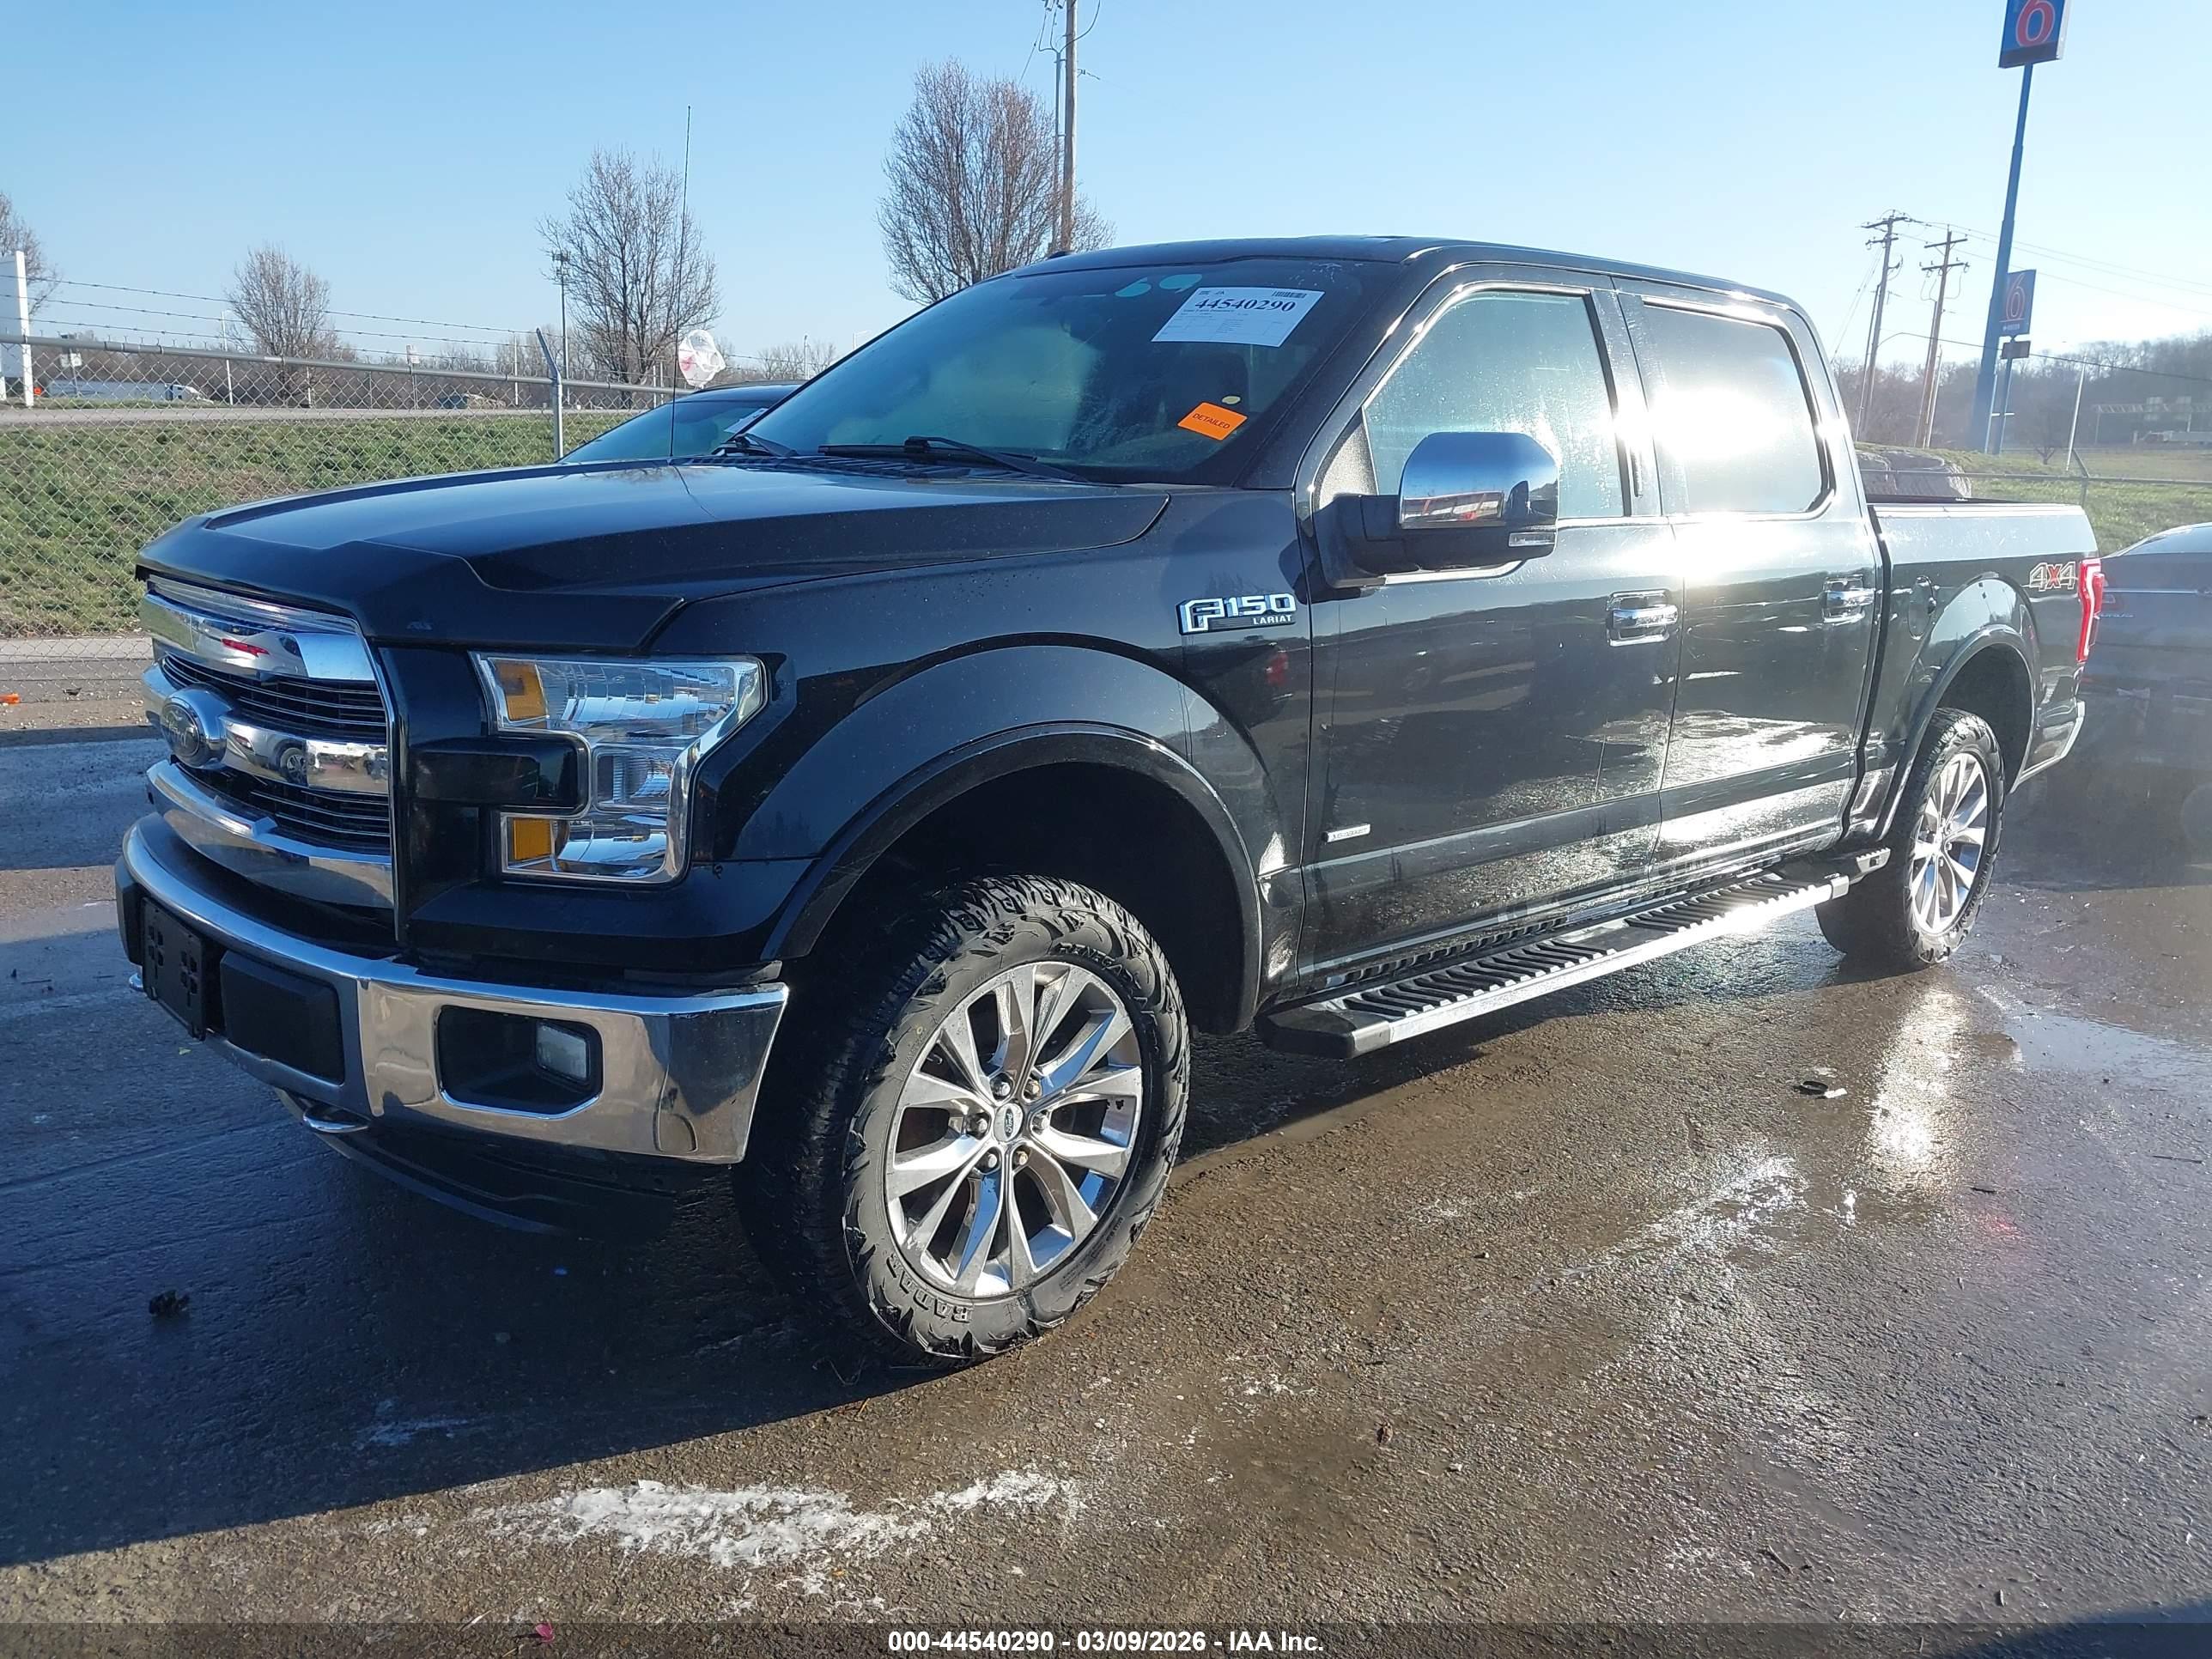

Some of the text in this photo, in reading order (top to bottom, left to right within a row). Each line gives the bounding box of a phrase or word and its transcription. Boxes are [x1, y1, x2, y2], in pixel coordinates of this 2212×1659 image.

[2005, 272, 2026, 319] 6
[1195, 298, 1296, 312] 44540290
[1192, 412, 1231, 430] DETAILED
[1253, 614, 1292, 625] LARIAT
[885, 1250, 972, 1323] RADAR
